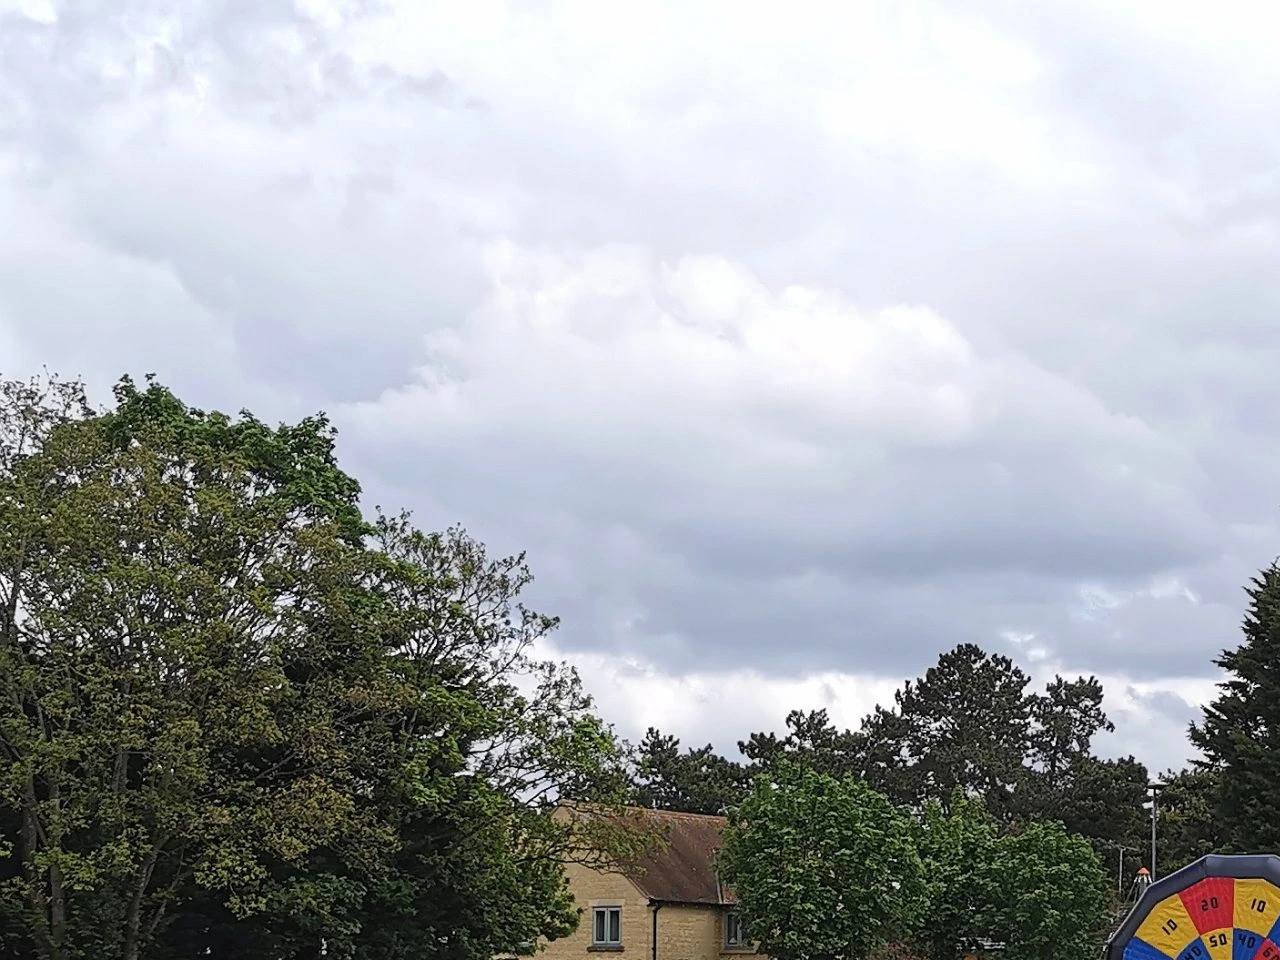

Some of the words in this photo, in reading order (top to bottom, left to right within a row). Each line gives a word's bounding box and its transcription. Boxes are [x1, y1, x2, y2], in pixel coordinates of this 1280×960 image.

[1201, 897, 1219, 911] 20
[1251, 898, 1266, 913] 10
[1161, 919, 1178, 936] 10
[1209, 933, 1227, 947] 50
[1238, 933, 1256, 949] 40
[1184, 945, 1202, 960] 40
